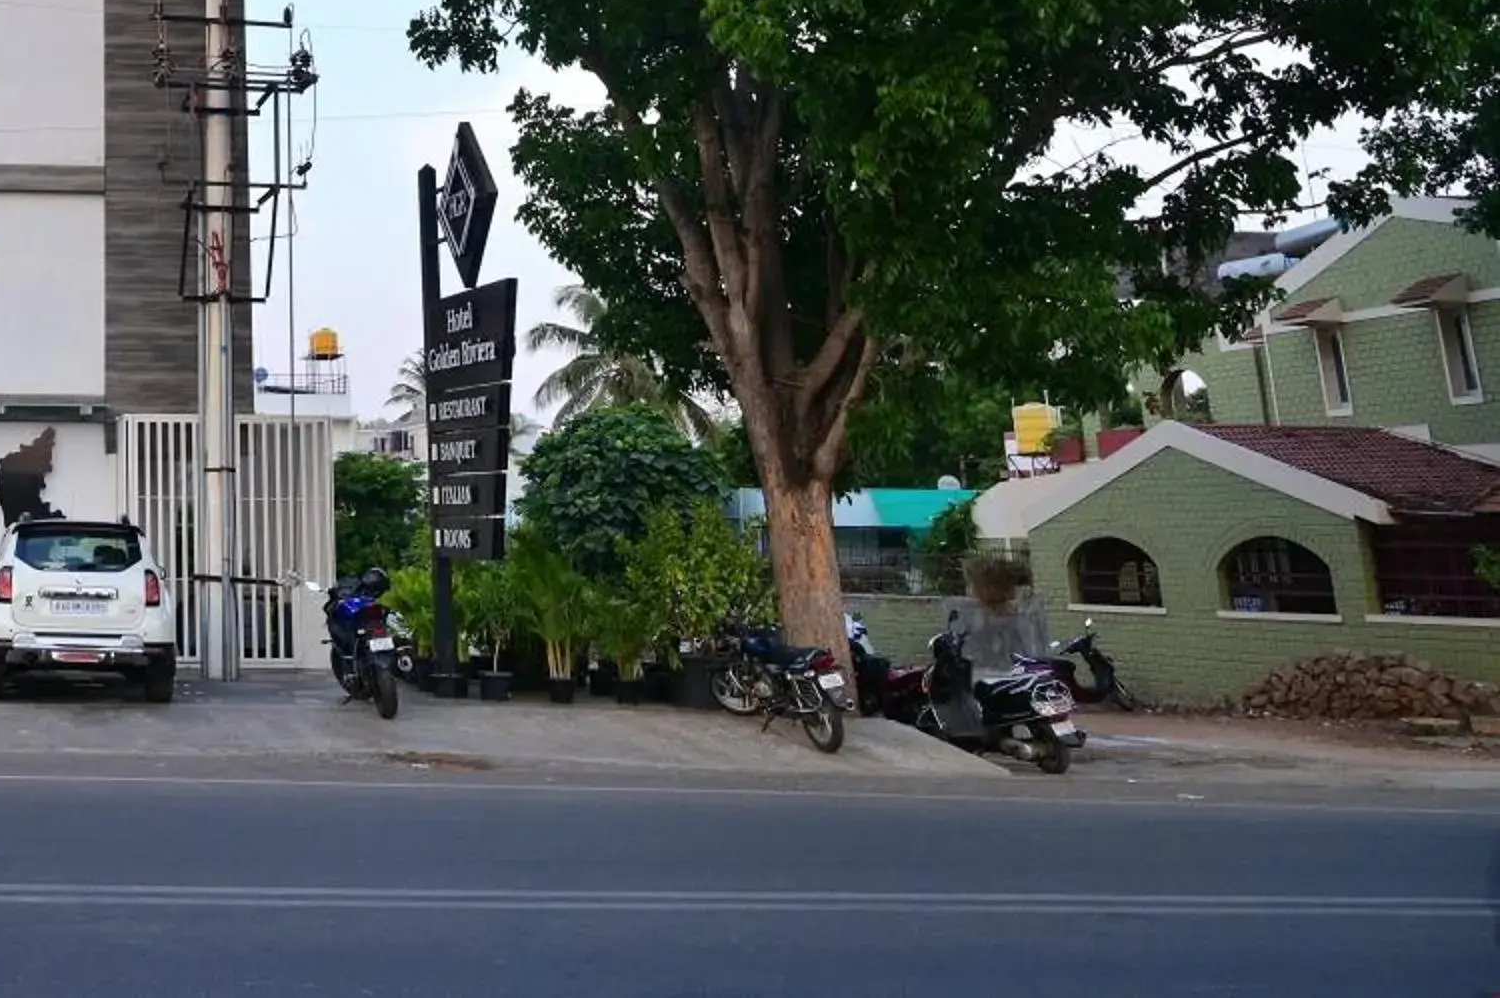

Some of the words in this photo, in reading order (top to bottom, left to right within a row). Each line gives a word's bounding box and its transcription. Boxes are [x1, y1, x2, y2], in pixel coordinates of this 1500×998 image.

[446, 301, 473, 333] Hotel
[428, 341, 461, 372] Golden
[461, 337, 496, 365] Riviera
[438, 395, 487, 420] RESTAURANT
[440, 439, 476, 465] BANQUET
[441, 485, 472, 505] ITALIAN
[443, 529, 472, 549] ROOMS
